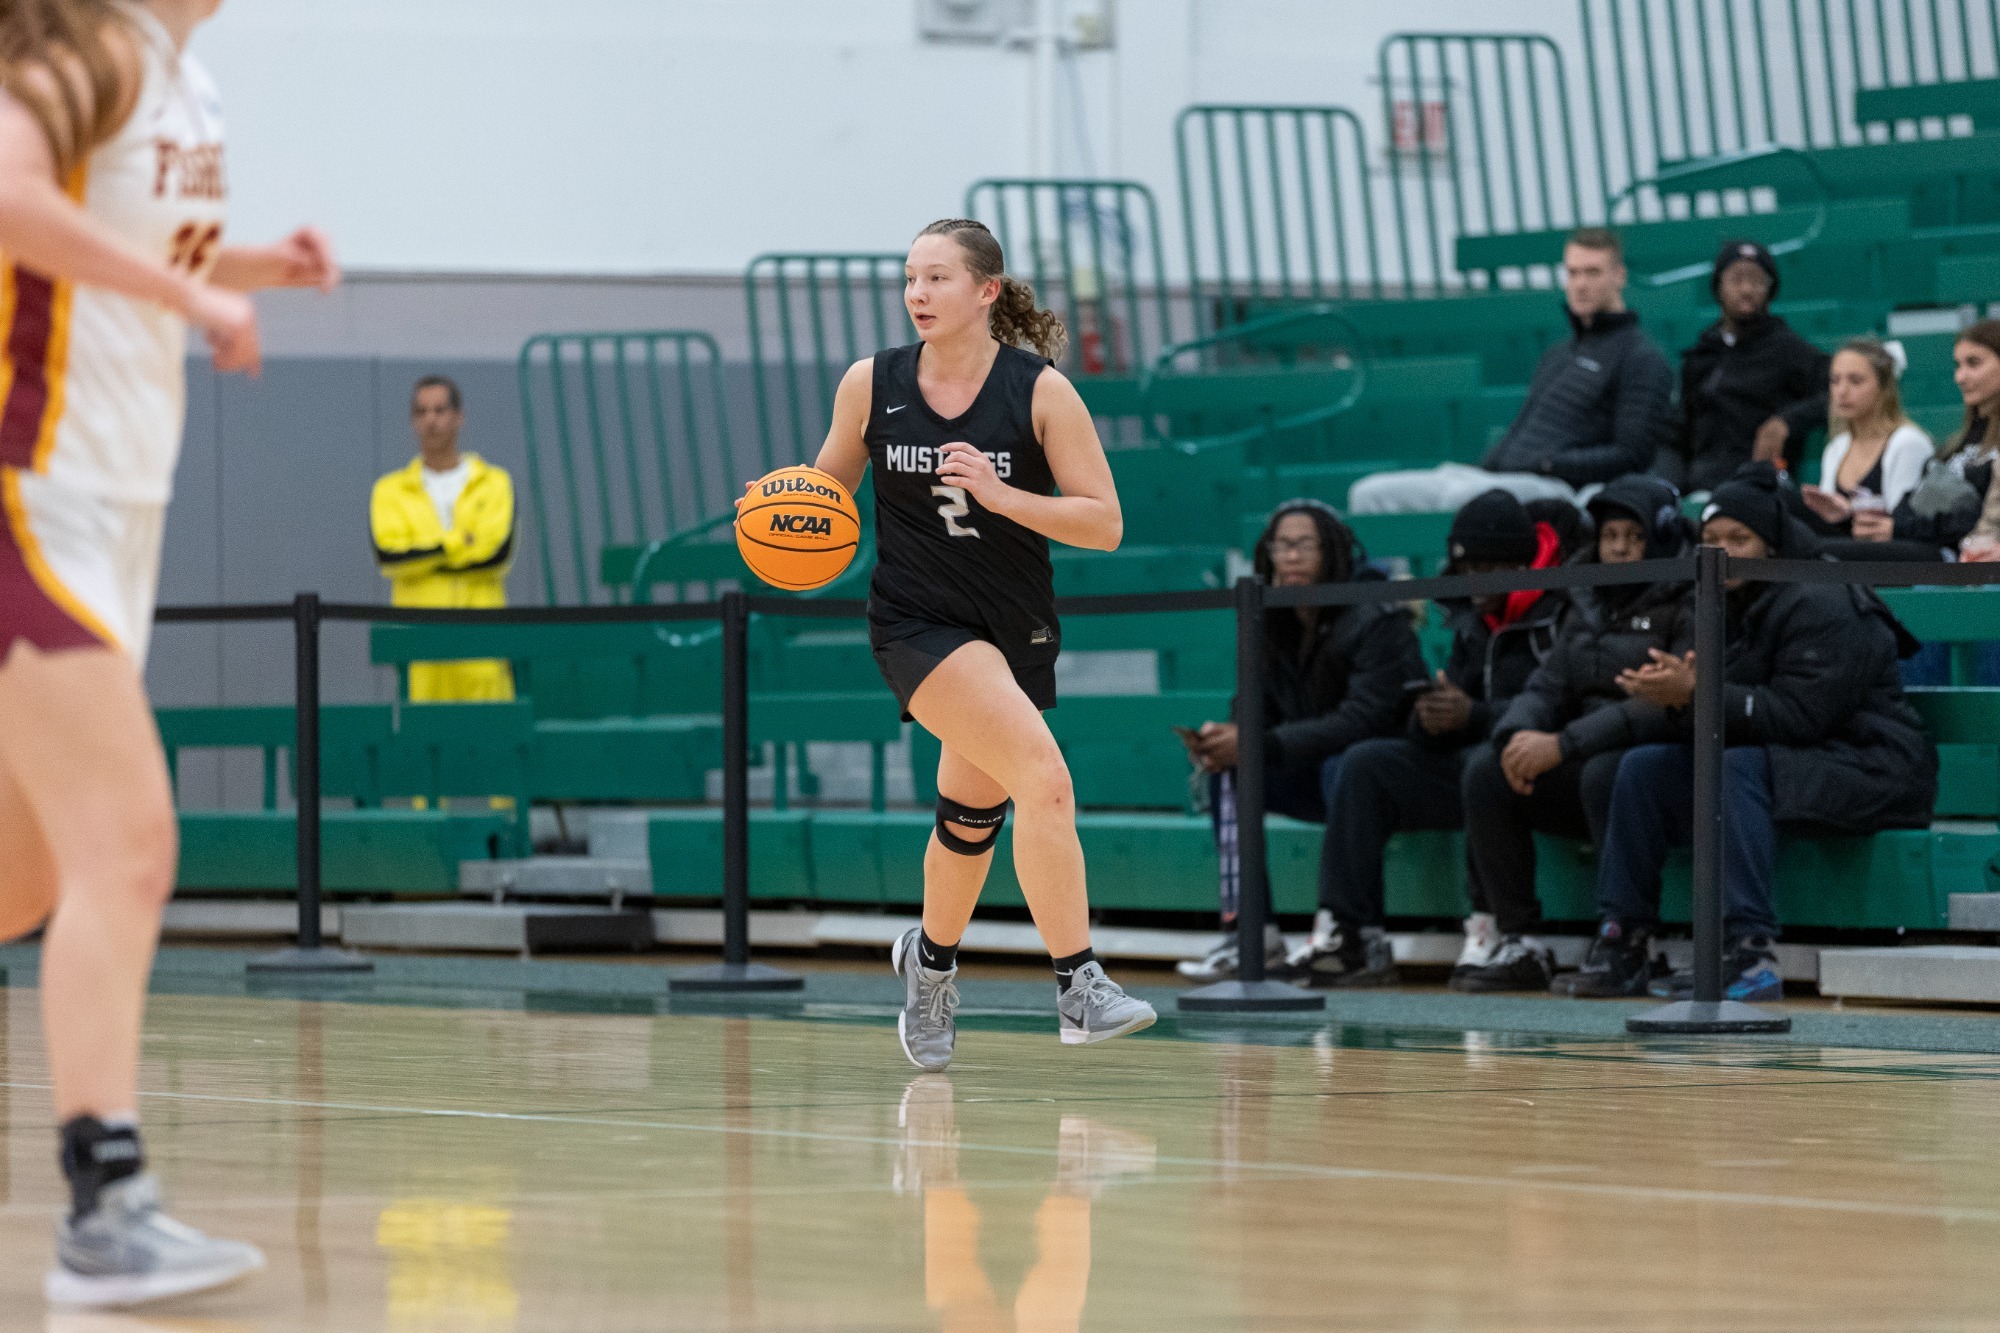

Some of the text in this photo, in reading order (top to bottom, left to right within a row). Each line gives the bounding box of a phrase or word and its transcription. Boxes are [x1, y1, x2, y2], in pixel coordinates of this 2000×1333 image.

[762, 477, 842, 505] Wilson
[769, 513, 832, 536] NCAA
[930, 485, 981, 539] 2
